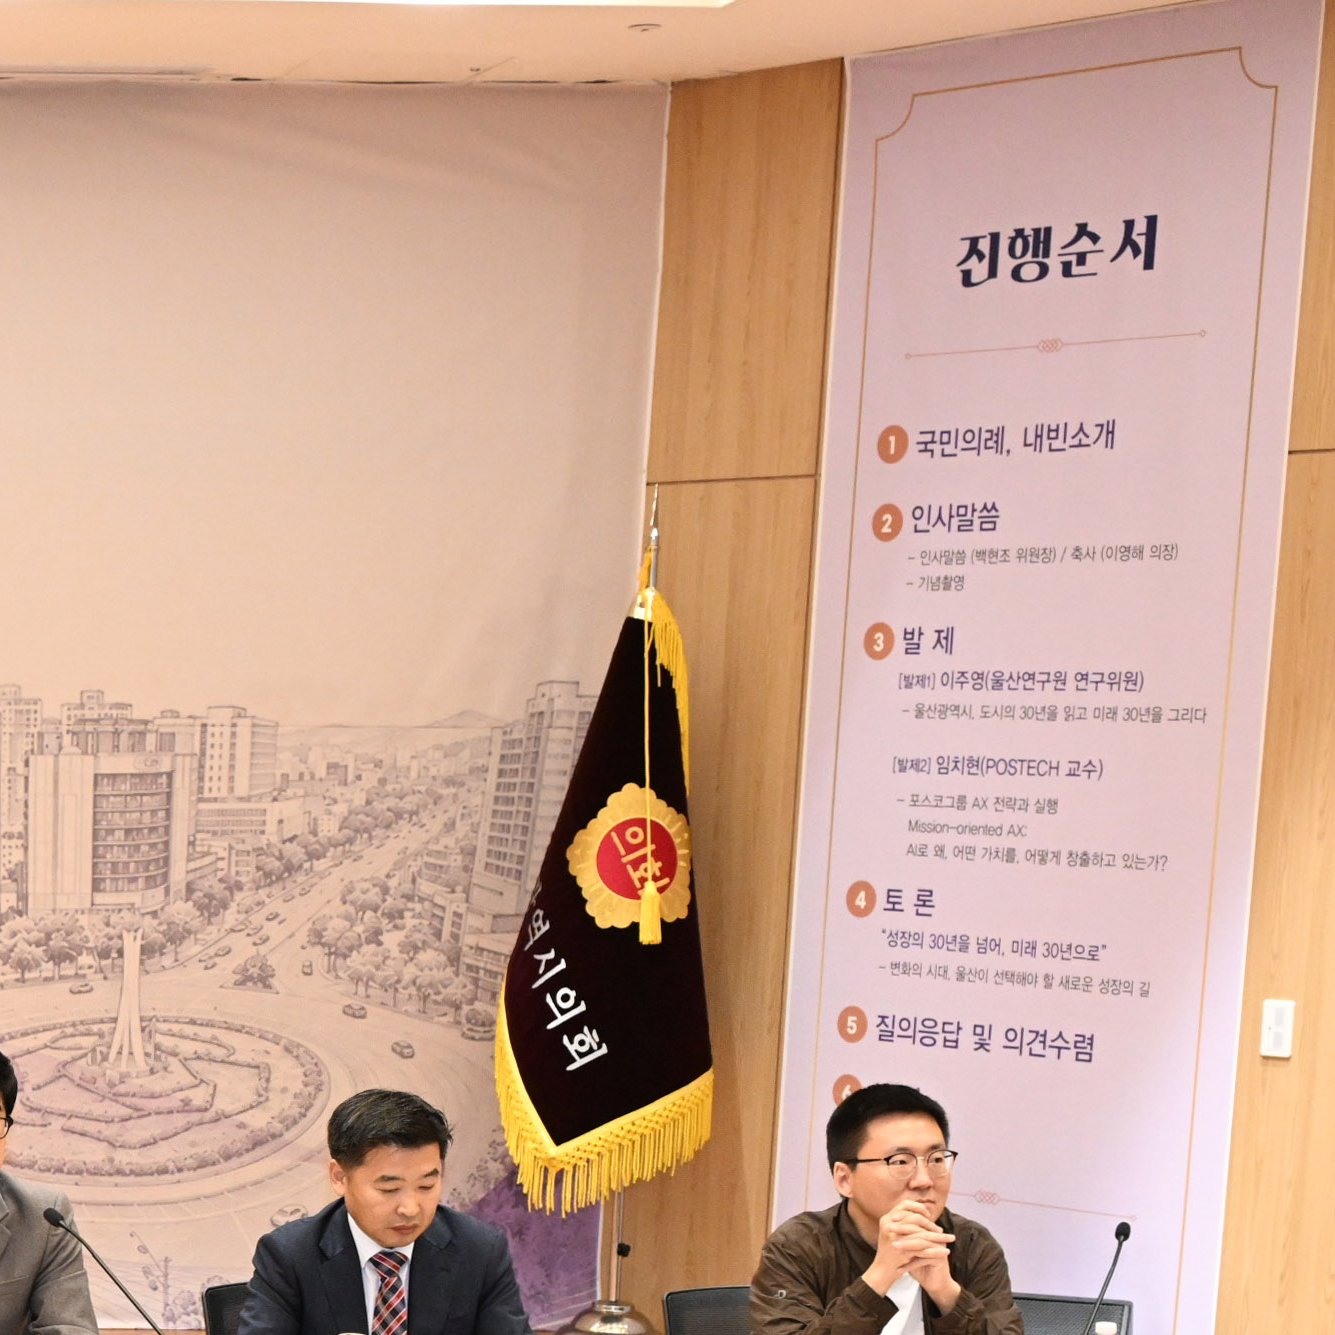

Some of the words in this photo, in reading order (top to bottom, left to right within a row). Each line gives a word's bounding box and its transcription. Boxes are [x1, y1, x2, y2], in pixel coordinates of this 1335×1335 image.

[956, 214, 1158, 288] 진행순서
[916, 425, 1011, 458] 국민의례,
[1023, 419, 1115, 454] 내빈소개
[911, 501, 1000, 534] 인사말씀
[920, 549, 966, 566] 인사말씀
[971, 548, 1010, 565] (백현조
[1016, 547, 1056, 564] 위원장)
[1071, 545, 1096, 561] 축사
[1101, 545, 1144, 561] (이영해
[1150, 544, 1178, 560] 의장)
[918, 575, 965, 591] 기념촬영
[941, 670, 1068, 692] 이주영(울산연구원
[1074, 670, 1143, 693] 연구위원)
[980, 705, 1015, 720] 도시의
[1020, 705, 1058, 721] 30년을
[1064, 706, 1087, 721] 읽고
[1093, 706, 1118, 722] 미래
[1123, 706, 1162, 723] 30년을
[1168, 707, 1206, 724] 그리다
[936, 755, 1060, 777] 임치현(POSTECH
[1066, 760, 1103, 780] 교수)
[909, 795, 966, 811] 포스코그룹
[972, 798, 988, 810] AX
[994, 797, 1029, 813] 전략과
[1034, 798, 1058, 814] 실행
[929, 933, 970, 953] 30년을
[976, 937, 1004, 956] 넘어,
[1011, 939, 1037, 958] 미래
[890, 960, 922, 978] 변화의
[956, 967, 989, 984] 울산이
[994, 969, 1038, 988] 선택해야
[1044, 973, 1053, 990] 할
[1059, 975, 1093, 993] 새로운
[1099, 978, 1134, 996] 성장의
[1139, 981, 1150, 997] 길
[876, 1014, 962, 1049] 질의응답
[973, 1024, 992, 1052] 및
[1003, 1027, 1095, 1063] 의견수렴
